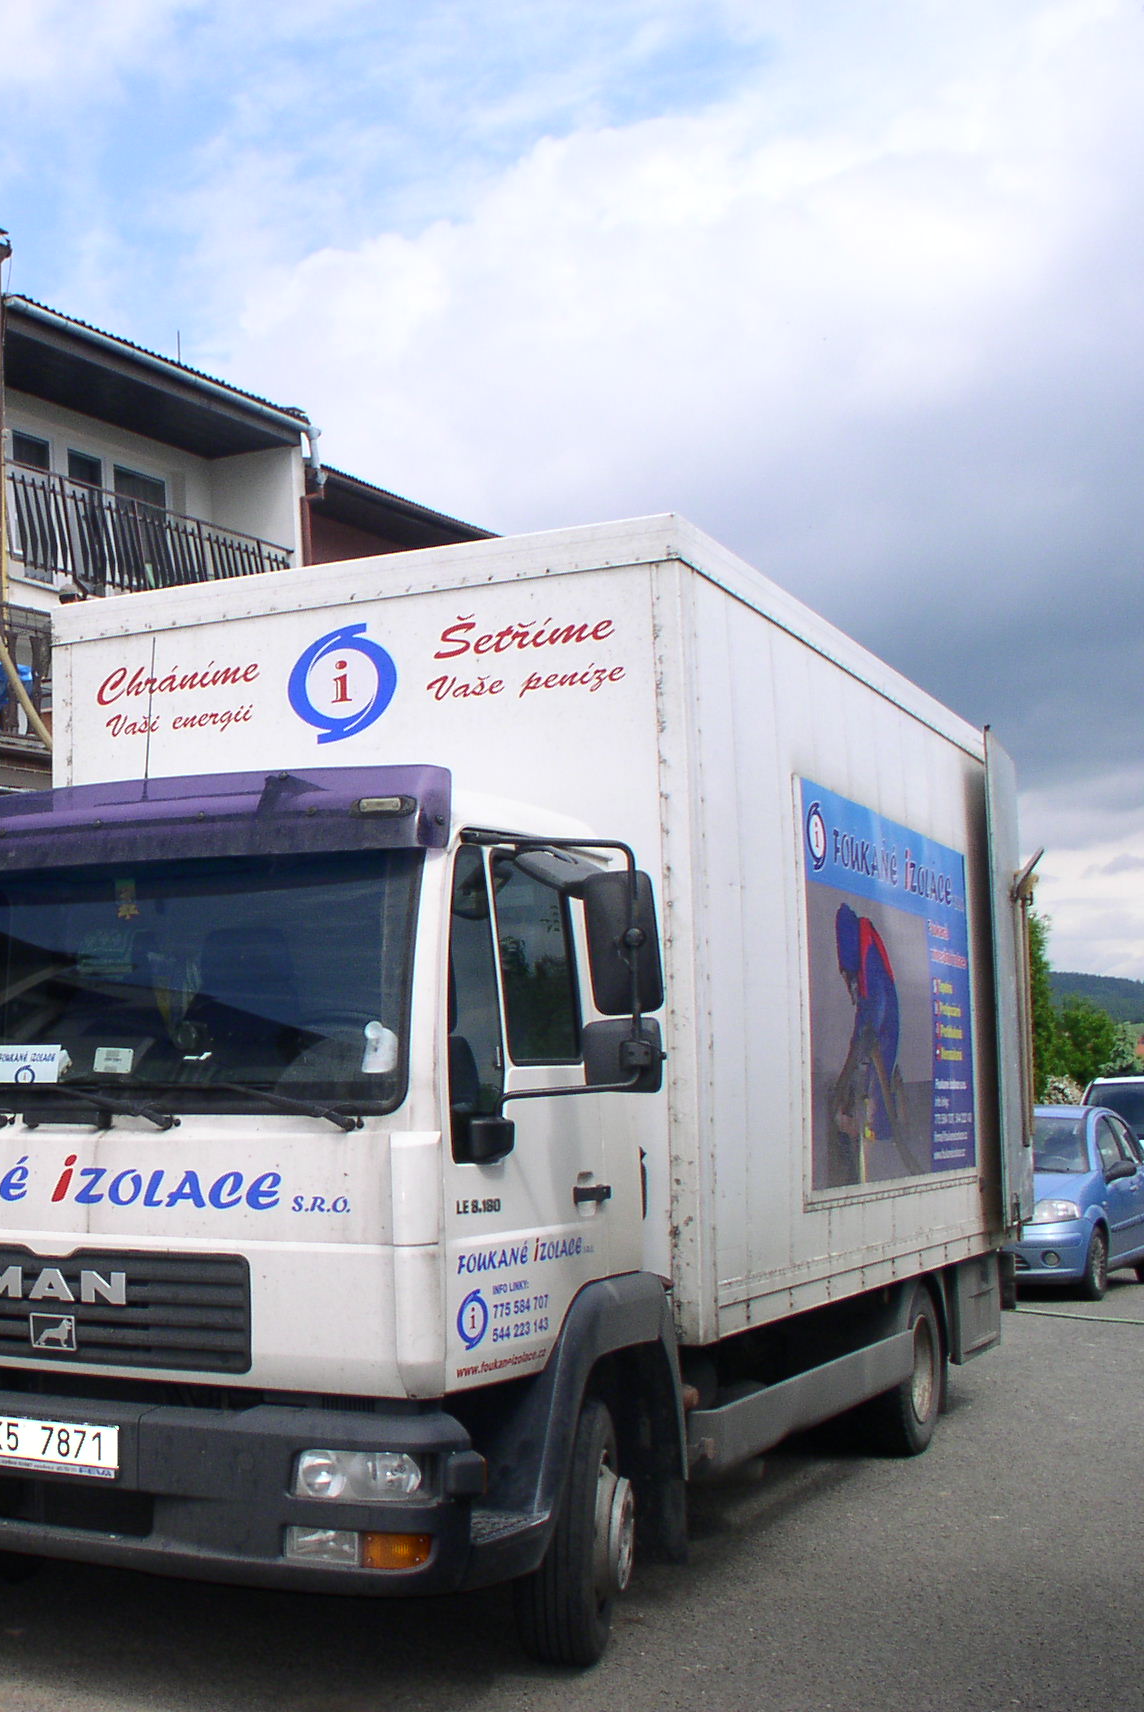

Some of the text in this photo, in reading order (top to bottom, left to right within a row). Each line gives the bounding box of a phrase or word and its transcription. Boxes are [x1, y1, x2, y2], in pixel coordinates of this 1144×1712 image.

[433, 613, 617, 660] Šetříme
[97, 660, 260, 706] Chráníme
[426, 660, 626, 701] Vaše peníze
[106, 704, 254, 738] Vaši energii
[291, 1194, 353, 1215] S.R.O.
[456, 1197, 501, 1214] LE 8.180
[492, 1282, 508, 1295] INFO
[492, 1293, 549, 1319] 775 584 707
[492, 1316, 549, 1342] 544 223 143
[41, 1426, 102, 1461] 7871
